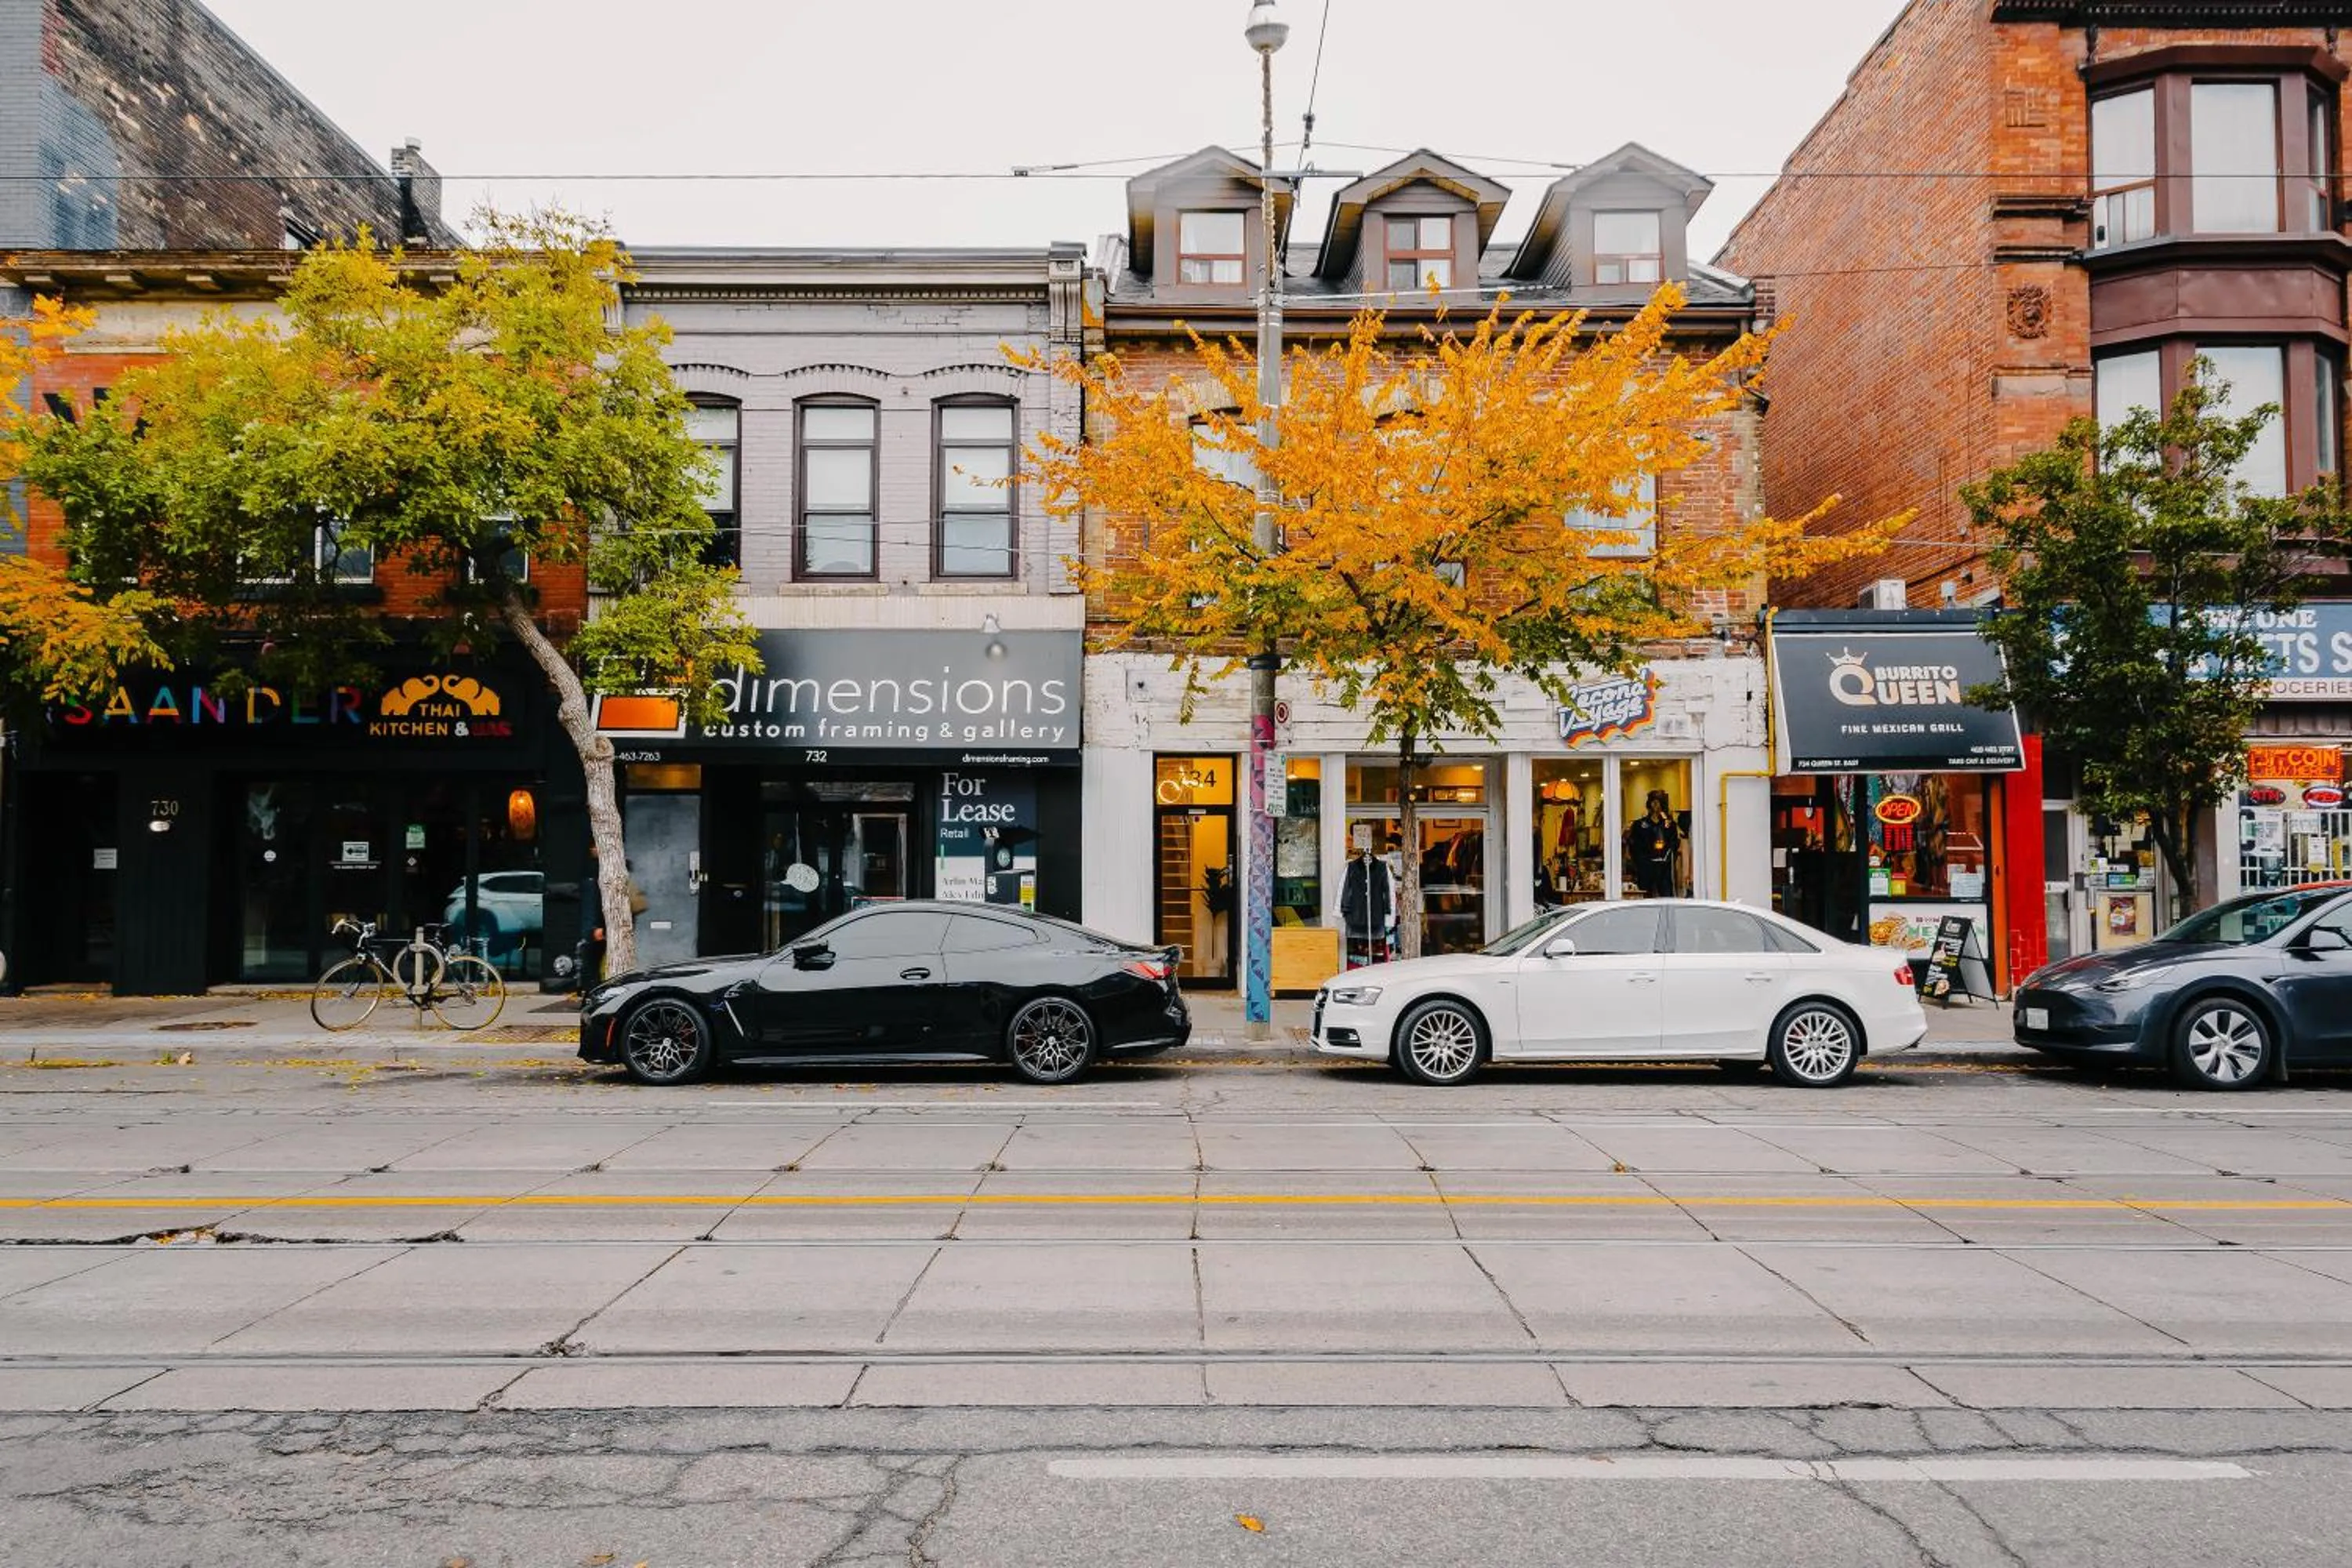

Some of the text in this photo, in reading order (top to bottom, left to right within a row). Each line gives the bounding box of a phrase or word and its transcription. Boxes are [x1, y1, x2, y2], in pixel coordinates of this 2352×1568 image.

[1875, 666, 1958, 681] BURRITO
[706, 662, 1066, 714] dimensions
[1828, 664, 1961, 706] QUEEN
[2270, 681, 2352, 694] OCERIE
[419, 703, 461, 717] THAI
[368, 721, 448, 736] KITCHEN
[454, 720, 470, 737] &
[703, 718, 1066, 742] custom framing & gallery
[1841, 724, 1965, 735] FINE MEXICAN GRILL
[613, 751, 661, 761] -463-7263
[804, 750, 828, 763] 732
[941, 771, 987, 796] For
[151, 800, 179, 816] 730
[941, 799, 1016, 822] Lease
[1880, 800, 1916, 818] OPEN
[940, 827, 970, 838] Retail
